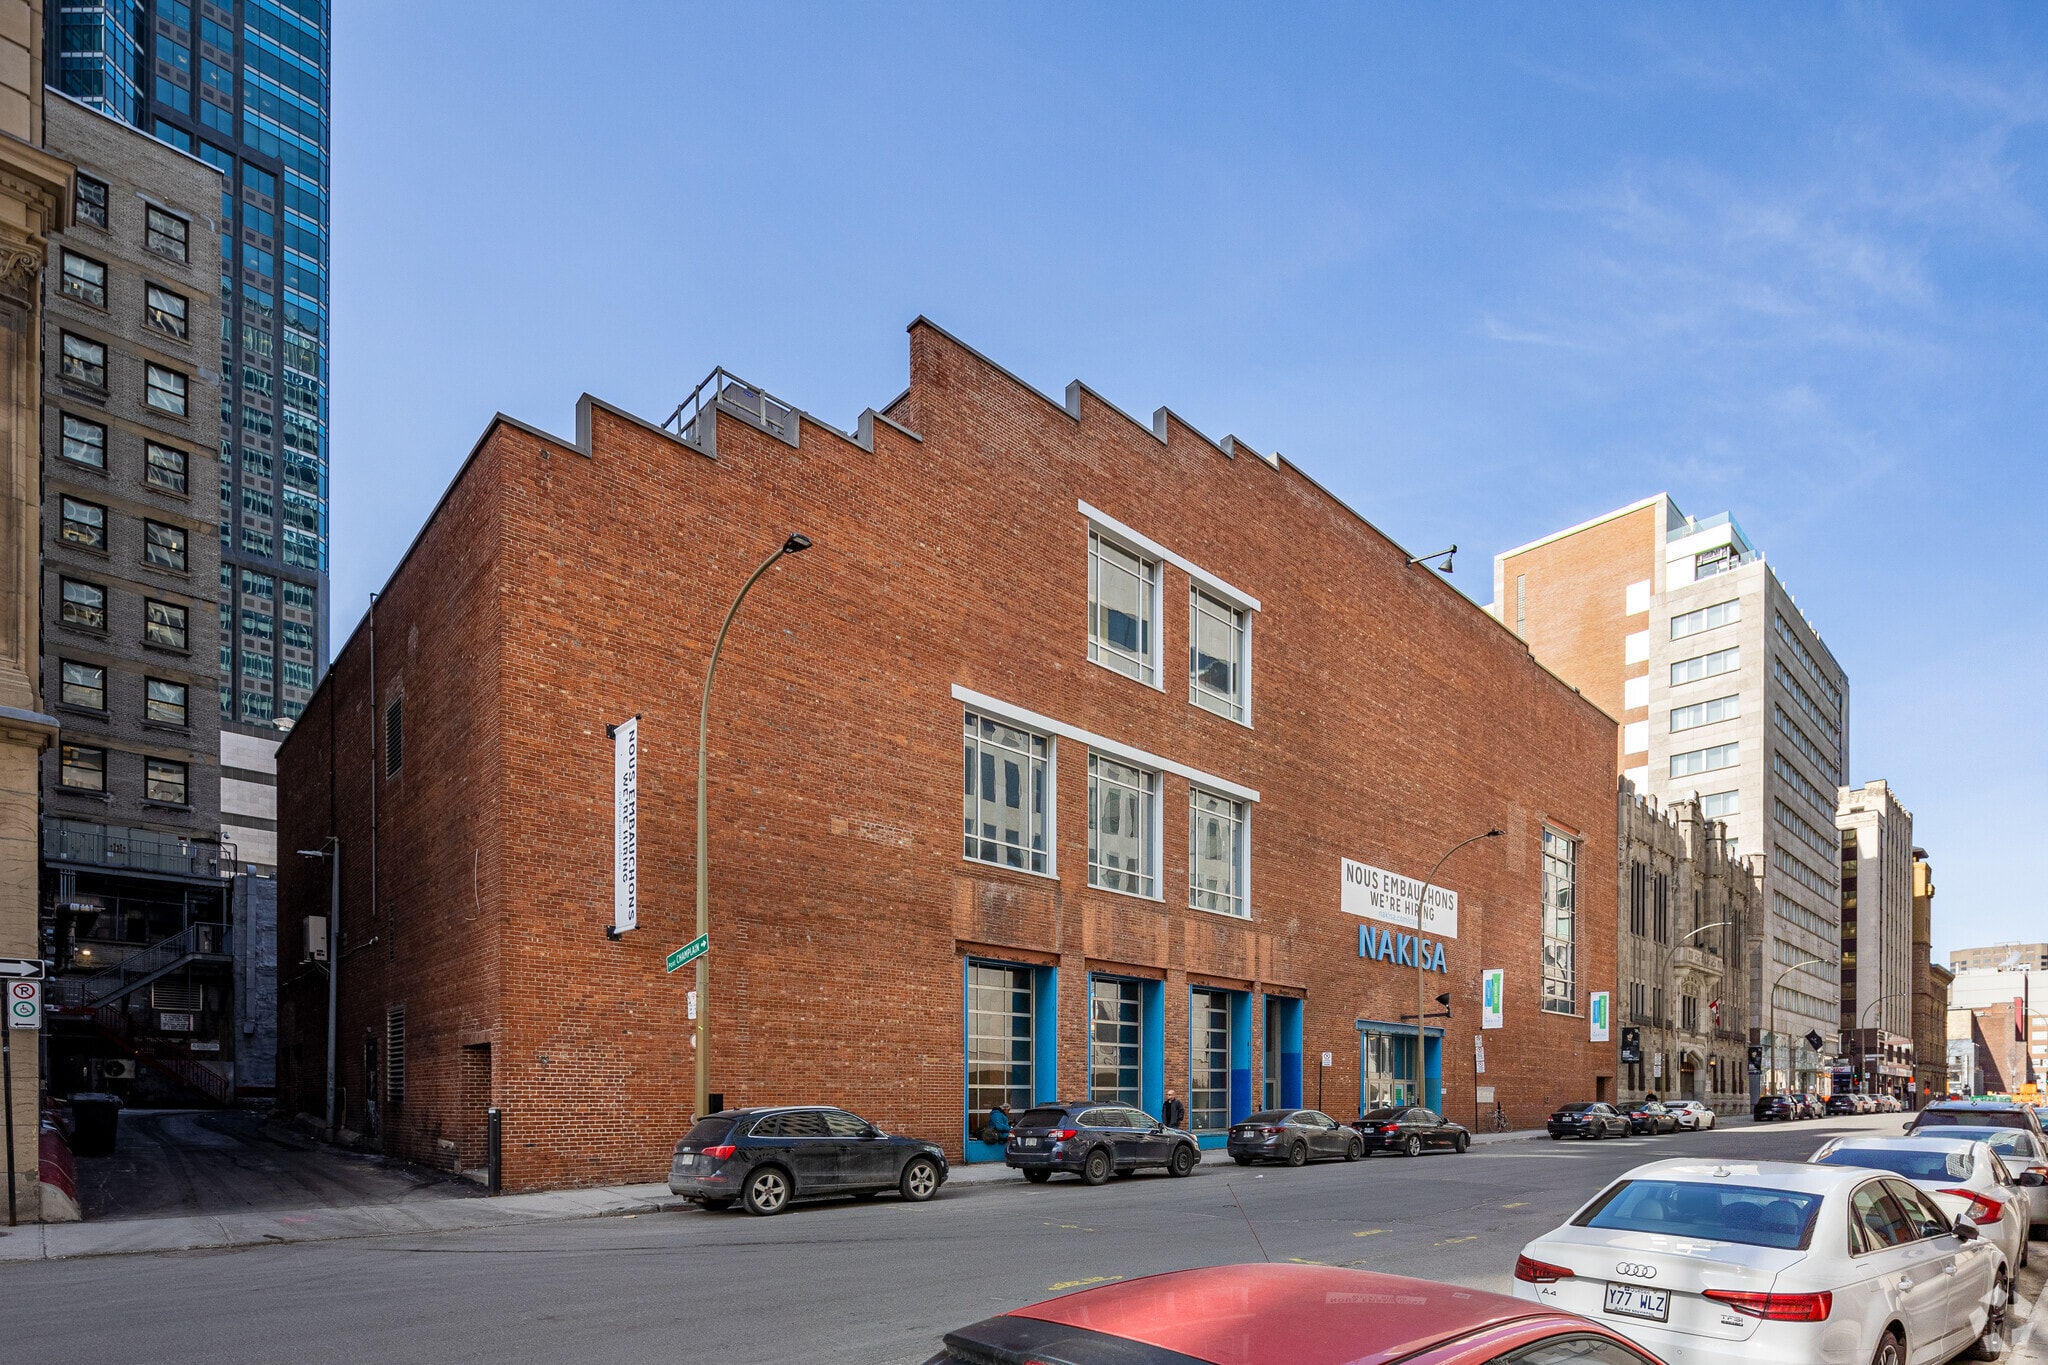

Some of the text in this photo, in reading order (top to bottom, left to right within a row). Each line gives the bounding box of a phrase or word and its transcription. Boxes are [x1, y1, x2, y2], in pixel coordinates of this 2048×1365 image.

[628, 729, 636, 782] NOUS
[1346, 863, 1379, 890] NOUS
[1370, 890, 1435, 921] WE'RE HIRNG
[676, 943, 700, 964] CHAMPLAIN
[1358, 924, 1448, 974] NAKISA
[1610, 1289, 1665, 1312] Y77 WLZ
